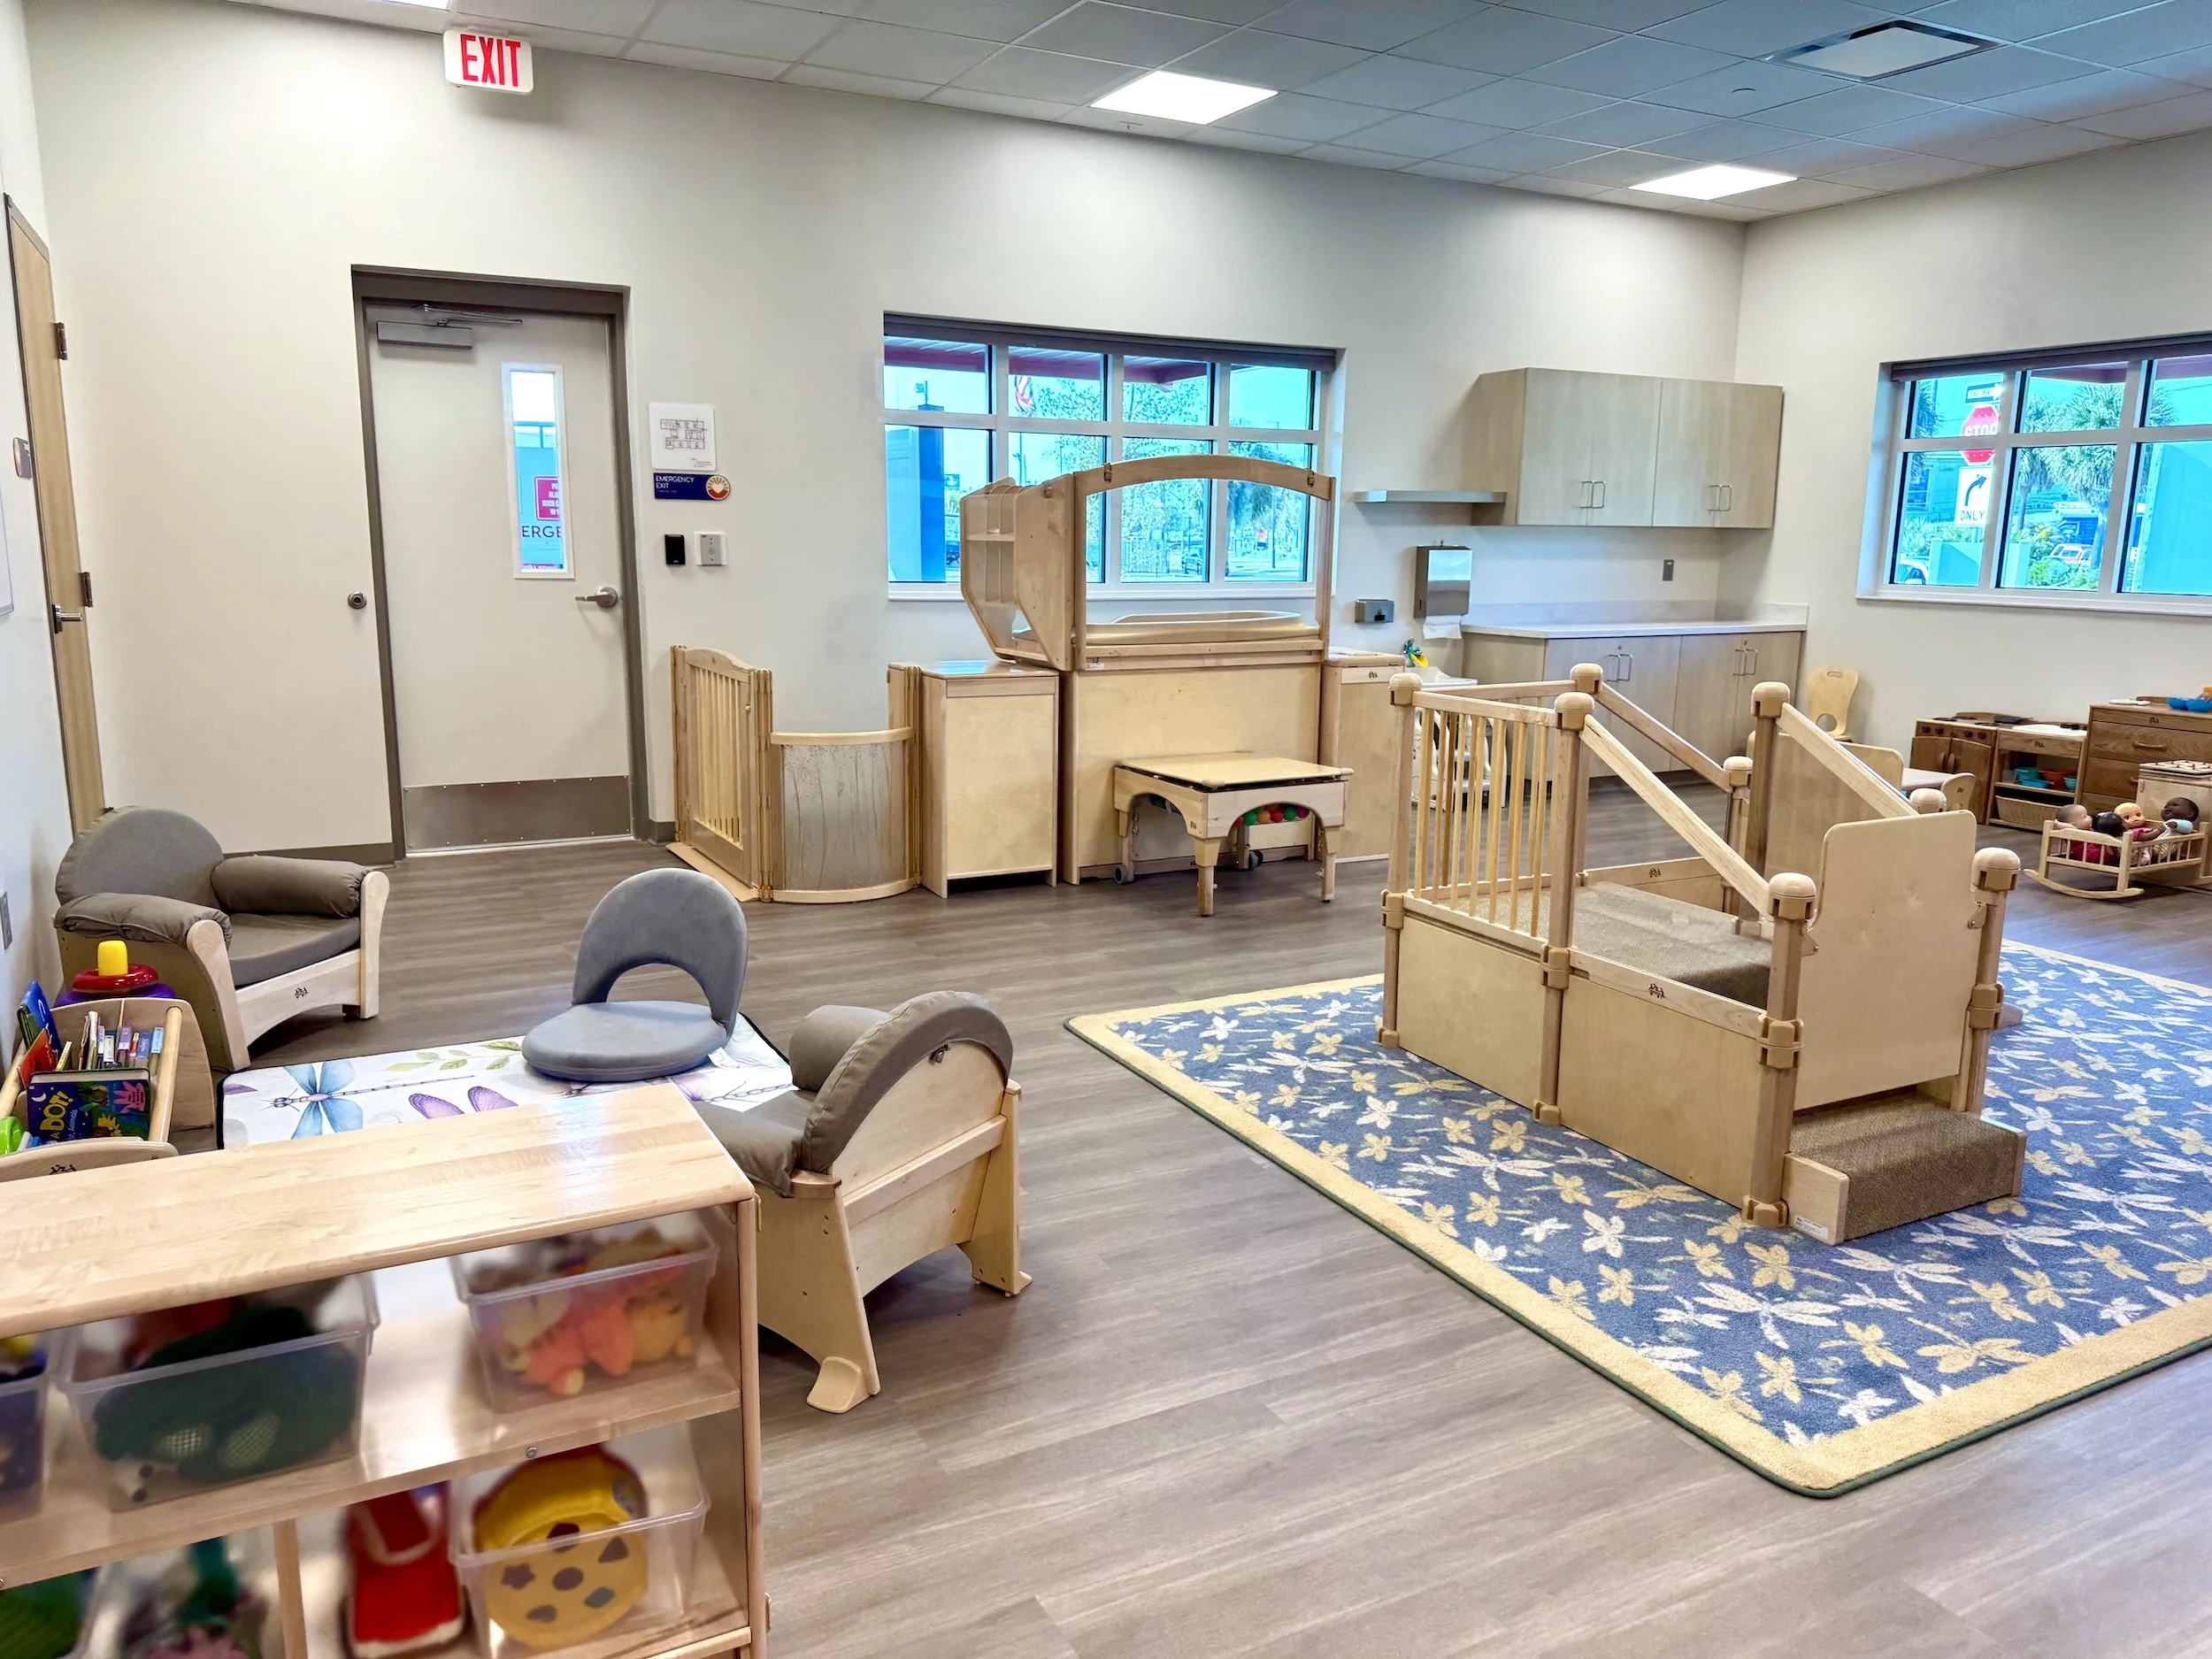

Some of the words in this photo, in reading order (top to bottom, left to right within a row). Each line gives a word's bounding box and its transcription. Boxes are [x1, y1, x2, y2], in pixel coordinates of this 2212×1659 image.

[460, 34, 521, 87] EXIT
[1960, 510, 1985, 521] ONLY
[69, 1109, 79, 1132] Animals
